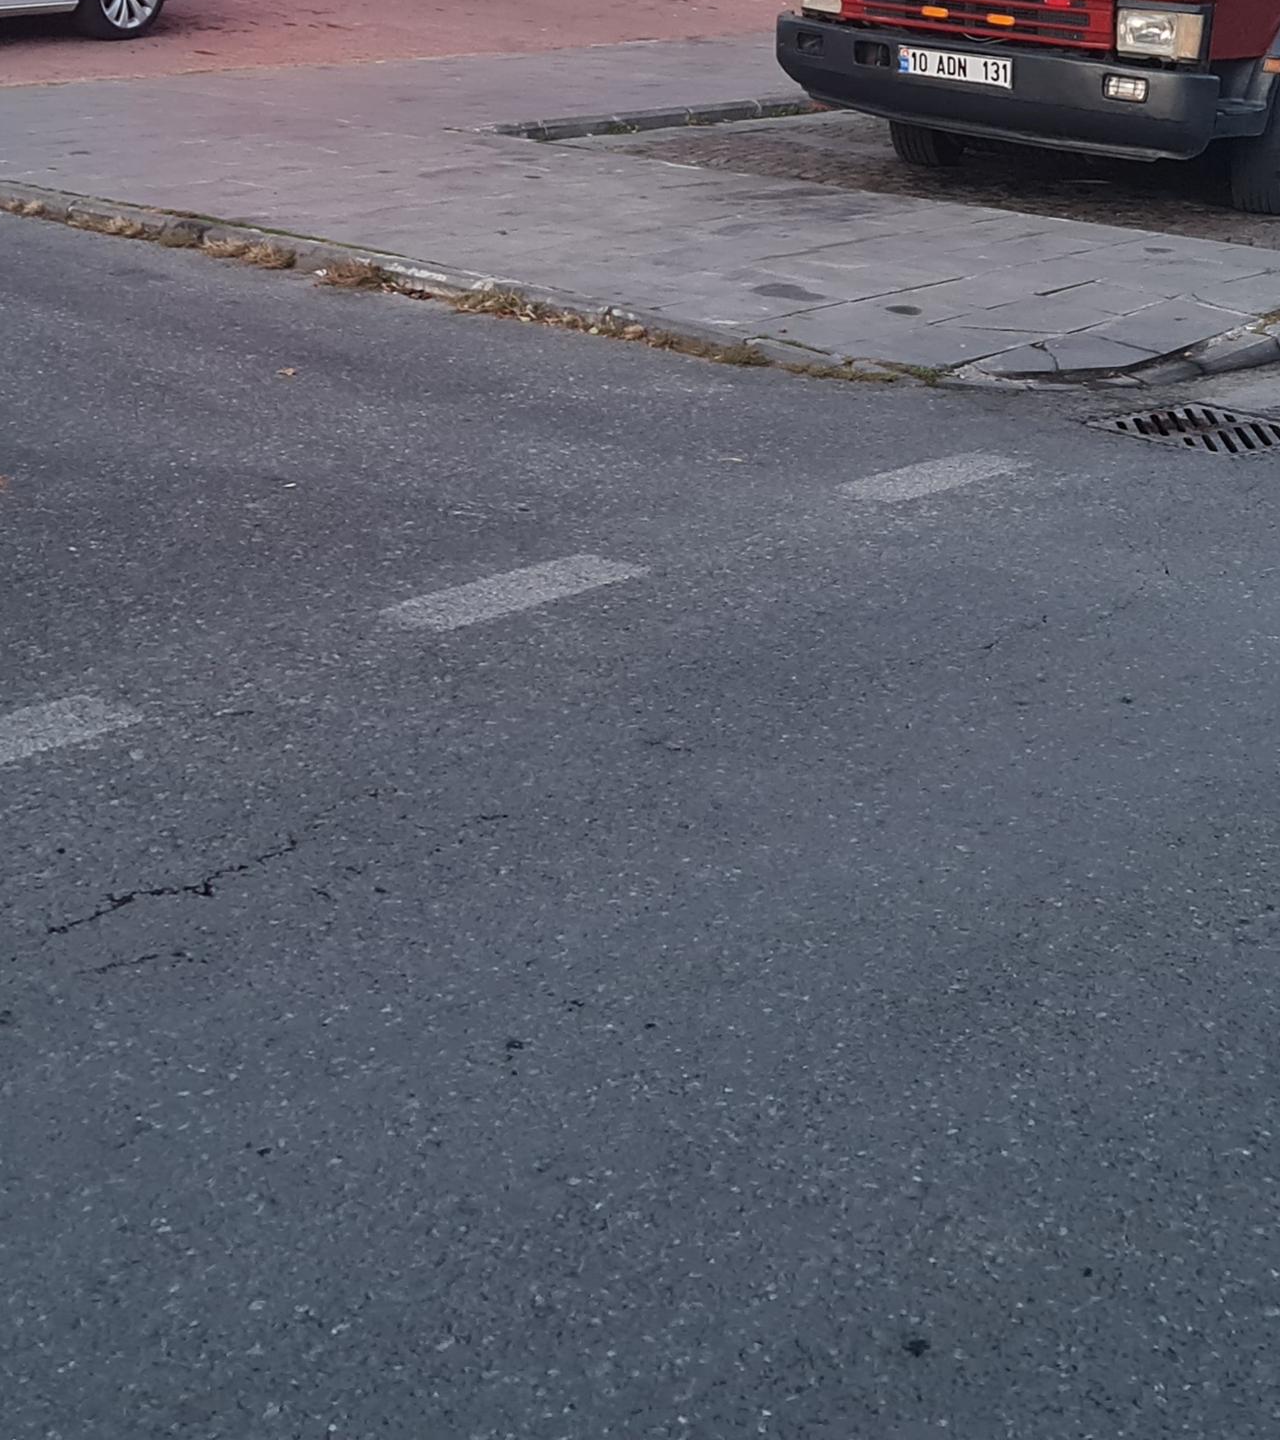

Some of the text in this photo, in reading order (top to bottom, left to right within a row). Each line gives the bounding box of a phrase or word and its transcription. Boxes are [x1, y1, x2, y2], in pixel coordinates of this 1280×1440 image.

[911, 51, 1008, 83] 10 ADN 131
